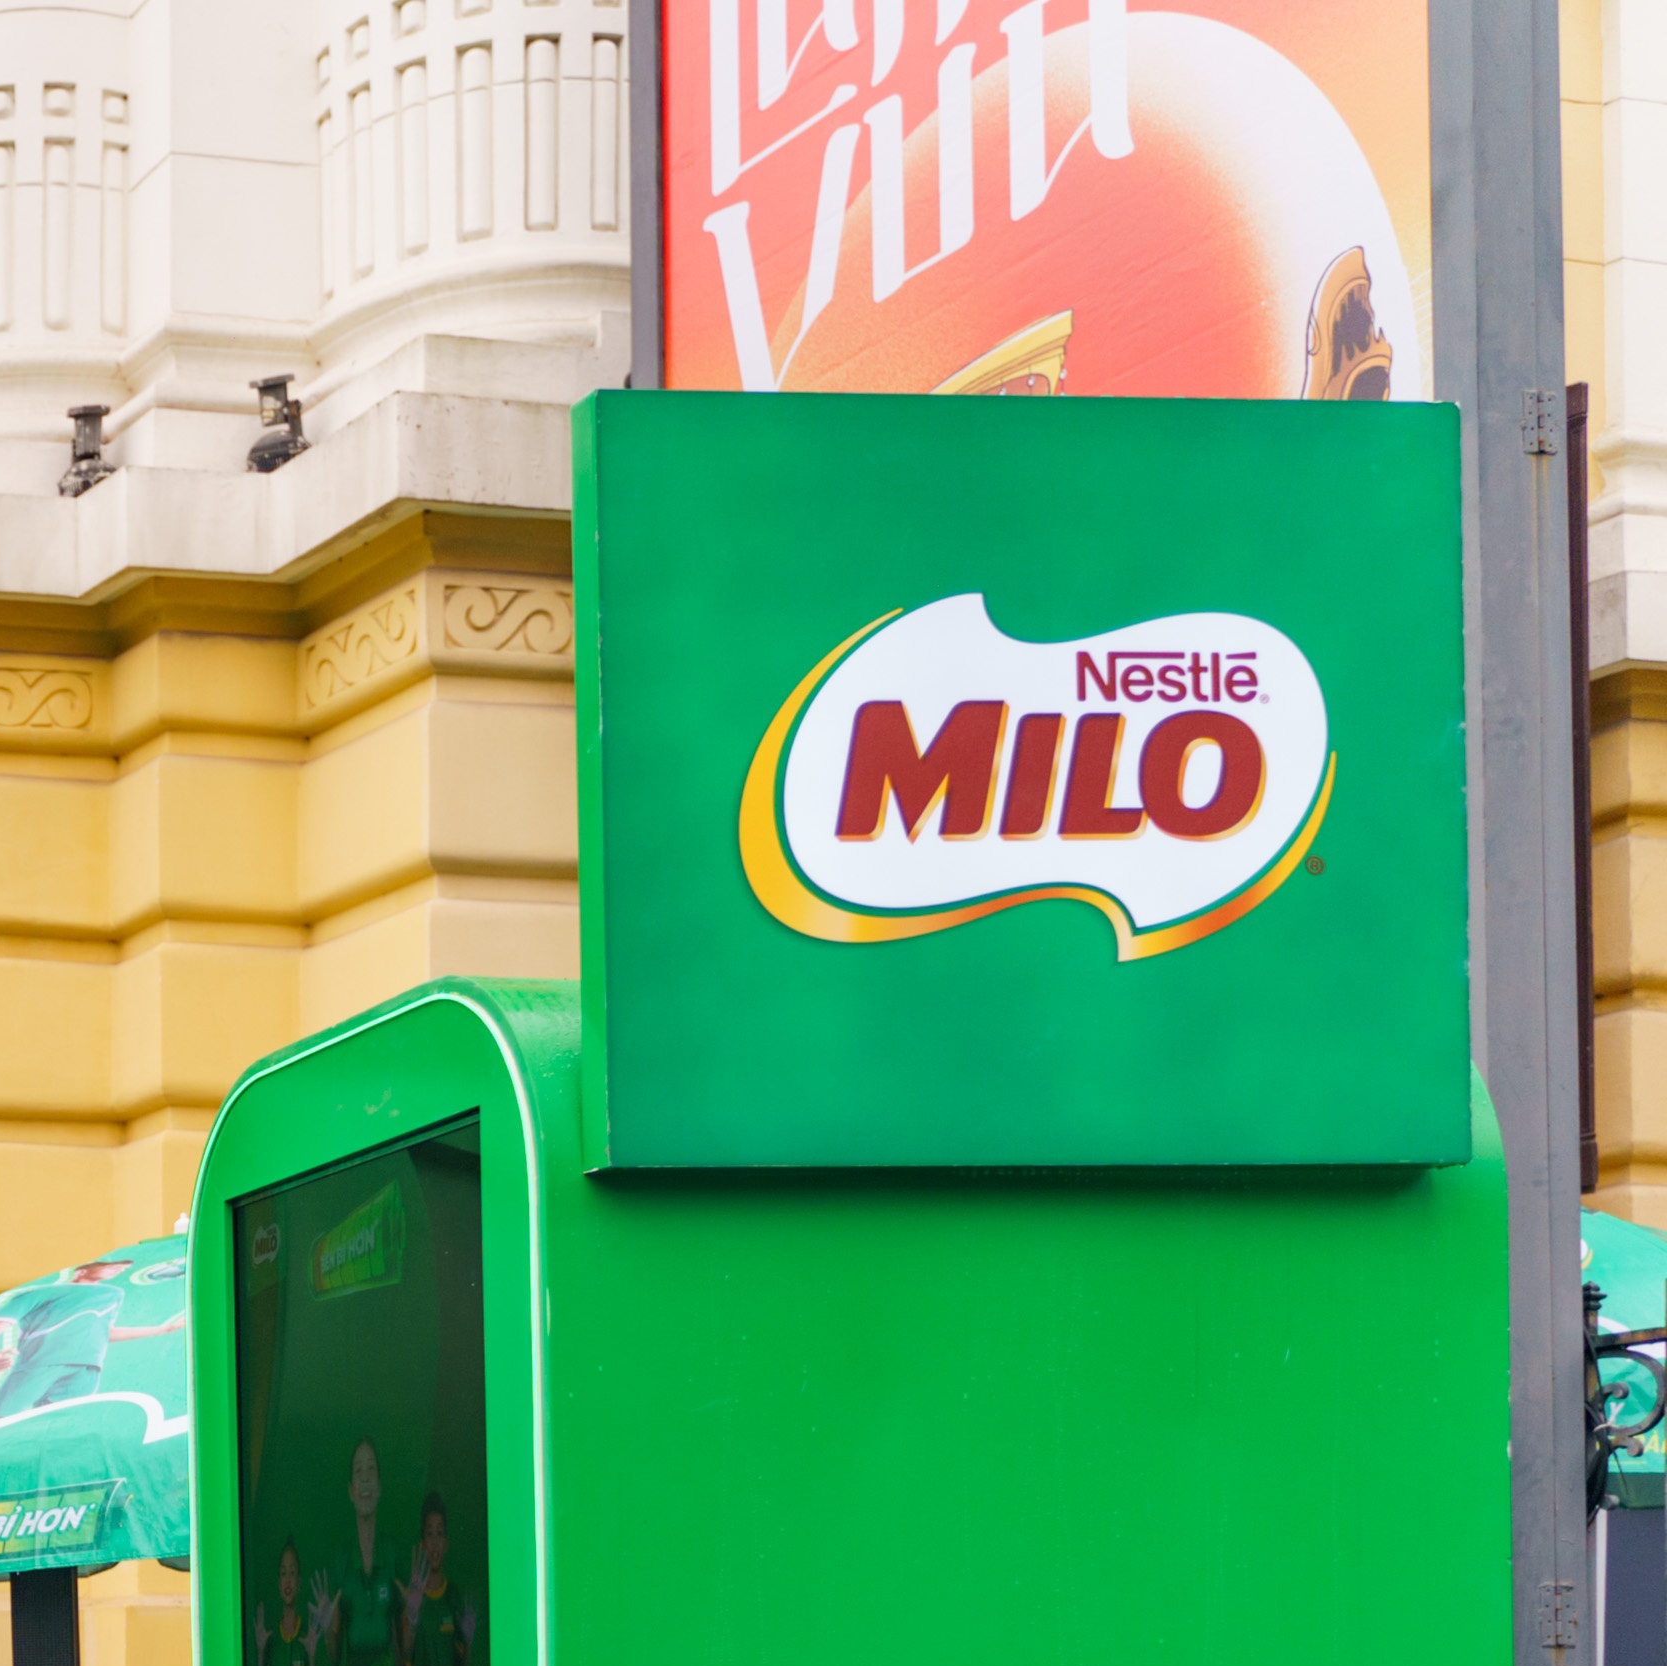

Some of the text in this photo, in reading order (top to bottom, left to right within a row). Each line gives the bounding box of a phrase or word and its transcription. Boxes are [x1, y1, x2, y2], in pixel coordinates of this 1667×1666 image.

[1076, 651, 1259, 703] Nestlé
[835, 699, 1267, 844] MILO
[17, 1503, 86, 1536] HƠN
